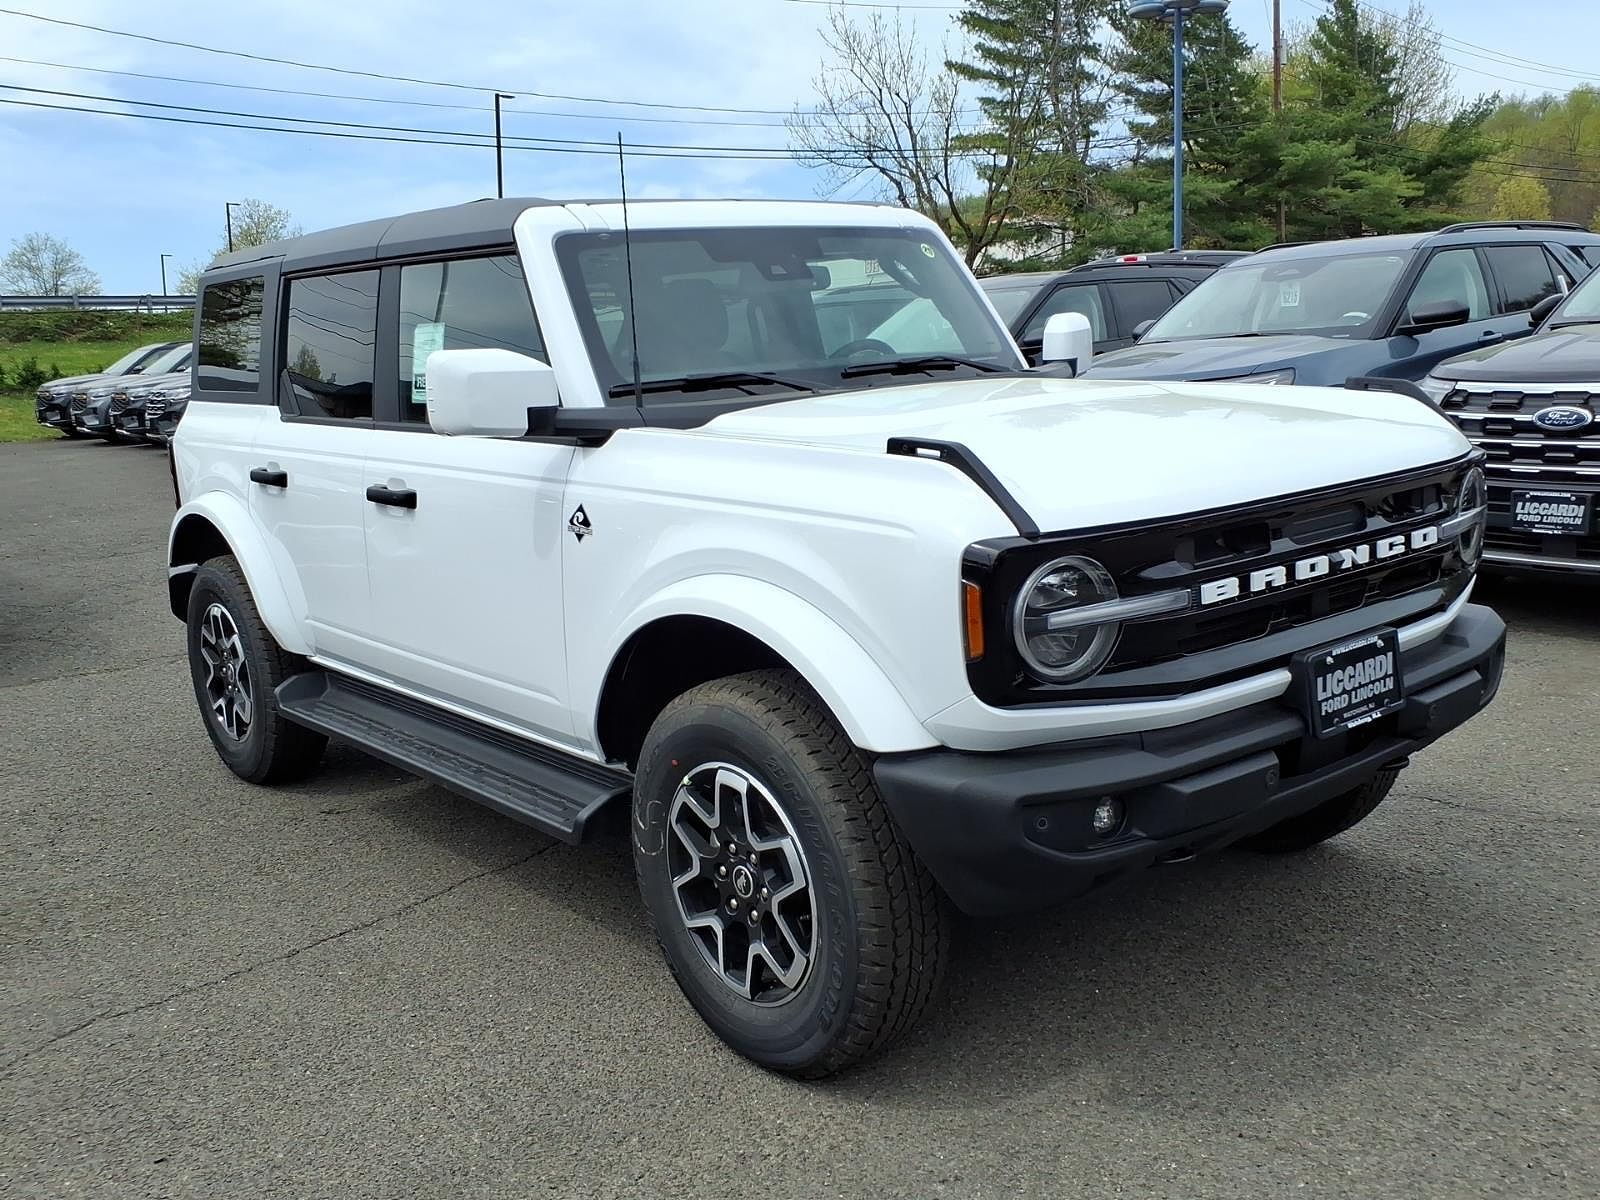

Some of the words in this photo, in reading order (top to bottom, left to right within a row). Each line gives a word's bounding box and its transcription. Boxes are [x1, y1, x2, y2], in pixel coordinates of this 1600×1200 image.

[1515, 501, 1585, 517] LICCARDI
[1517, 514, 1541, 522] FORD
[1542, 515, 1582, 525] LINCOLN
[1200, 526, 1428, 605] BRONCO
[1317, 651, 1393, 701] LICCARDI
[1321, 694, 1349, 715] FORD
[1351, 676, 1394, 703] LINCOLN
